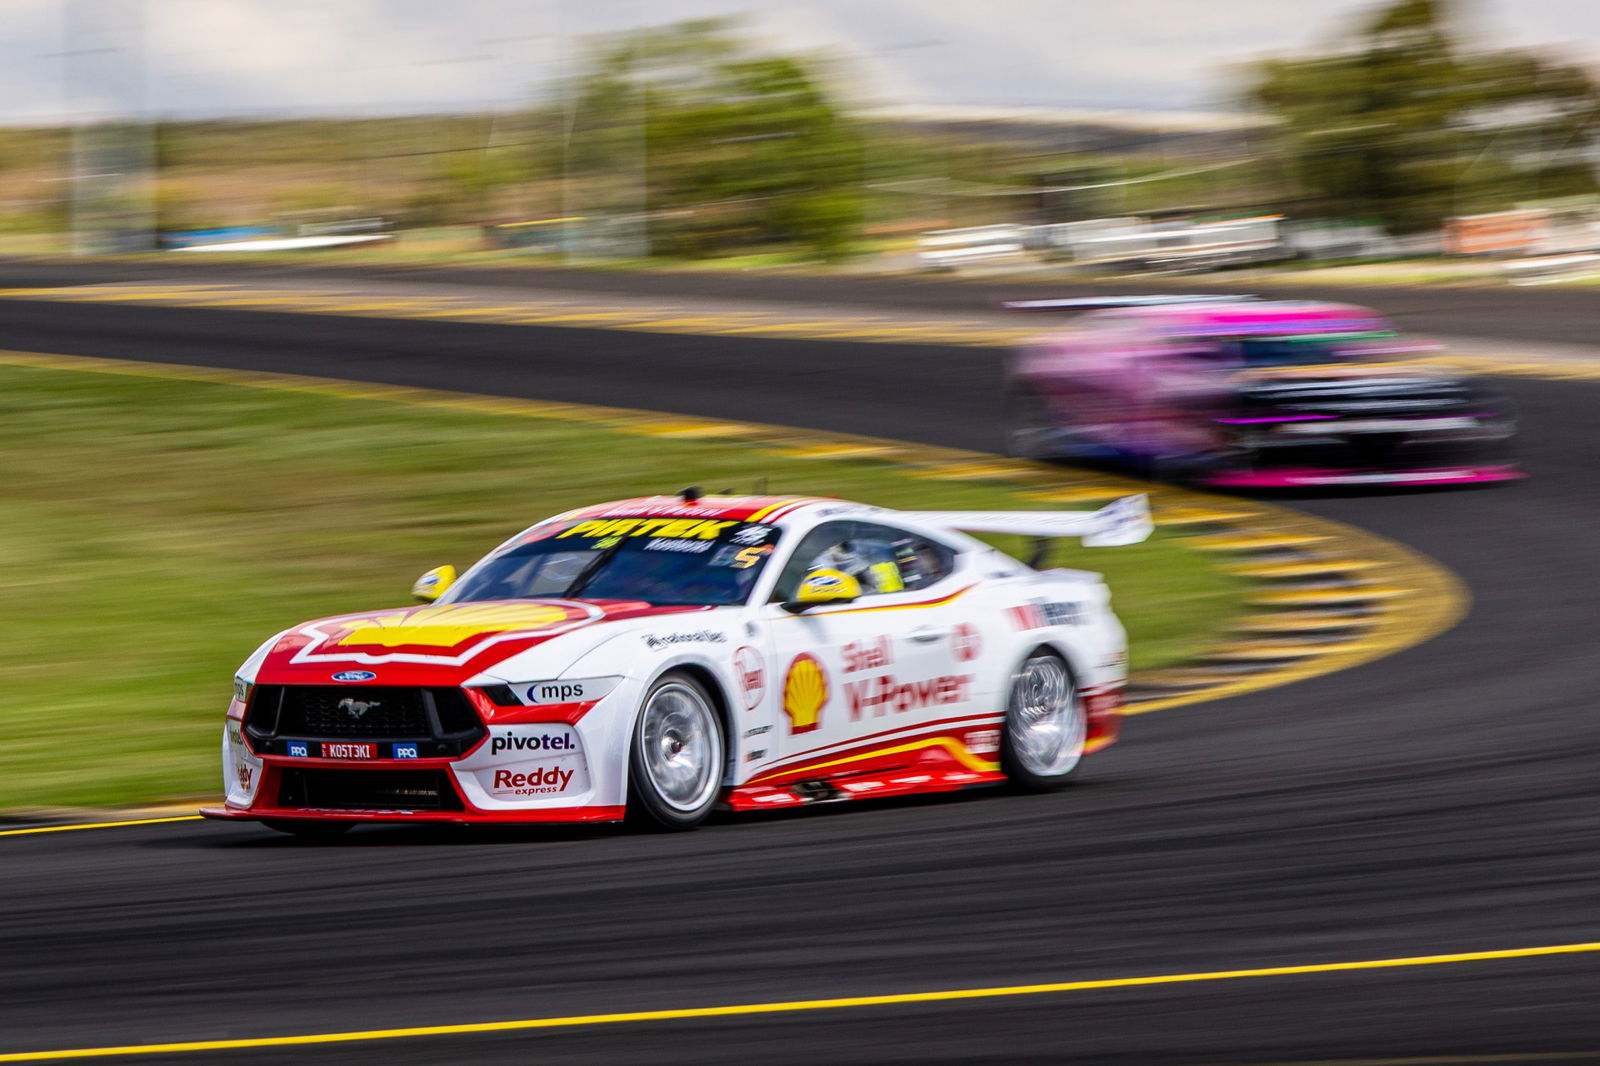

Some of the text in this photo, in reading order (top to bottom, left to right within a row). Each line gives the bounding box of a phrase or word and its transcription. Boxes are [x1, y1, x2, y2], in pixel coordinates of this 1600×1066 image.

[556, 518, 742, 540] PIRTEK
[542, 684, 583, 701] mps
[491, 731, 575, 755] pivotel.
[493, 766, 574, 793] Reddy
[515, 787, 557, 796] express
